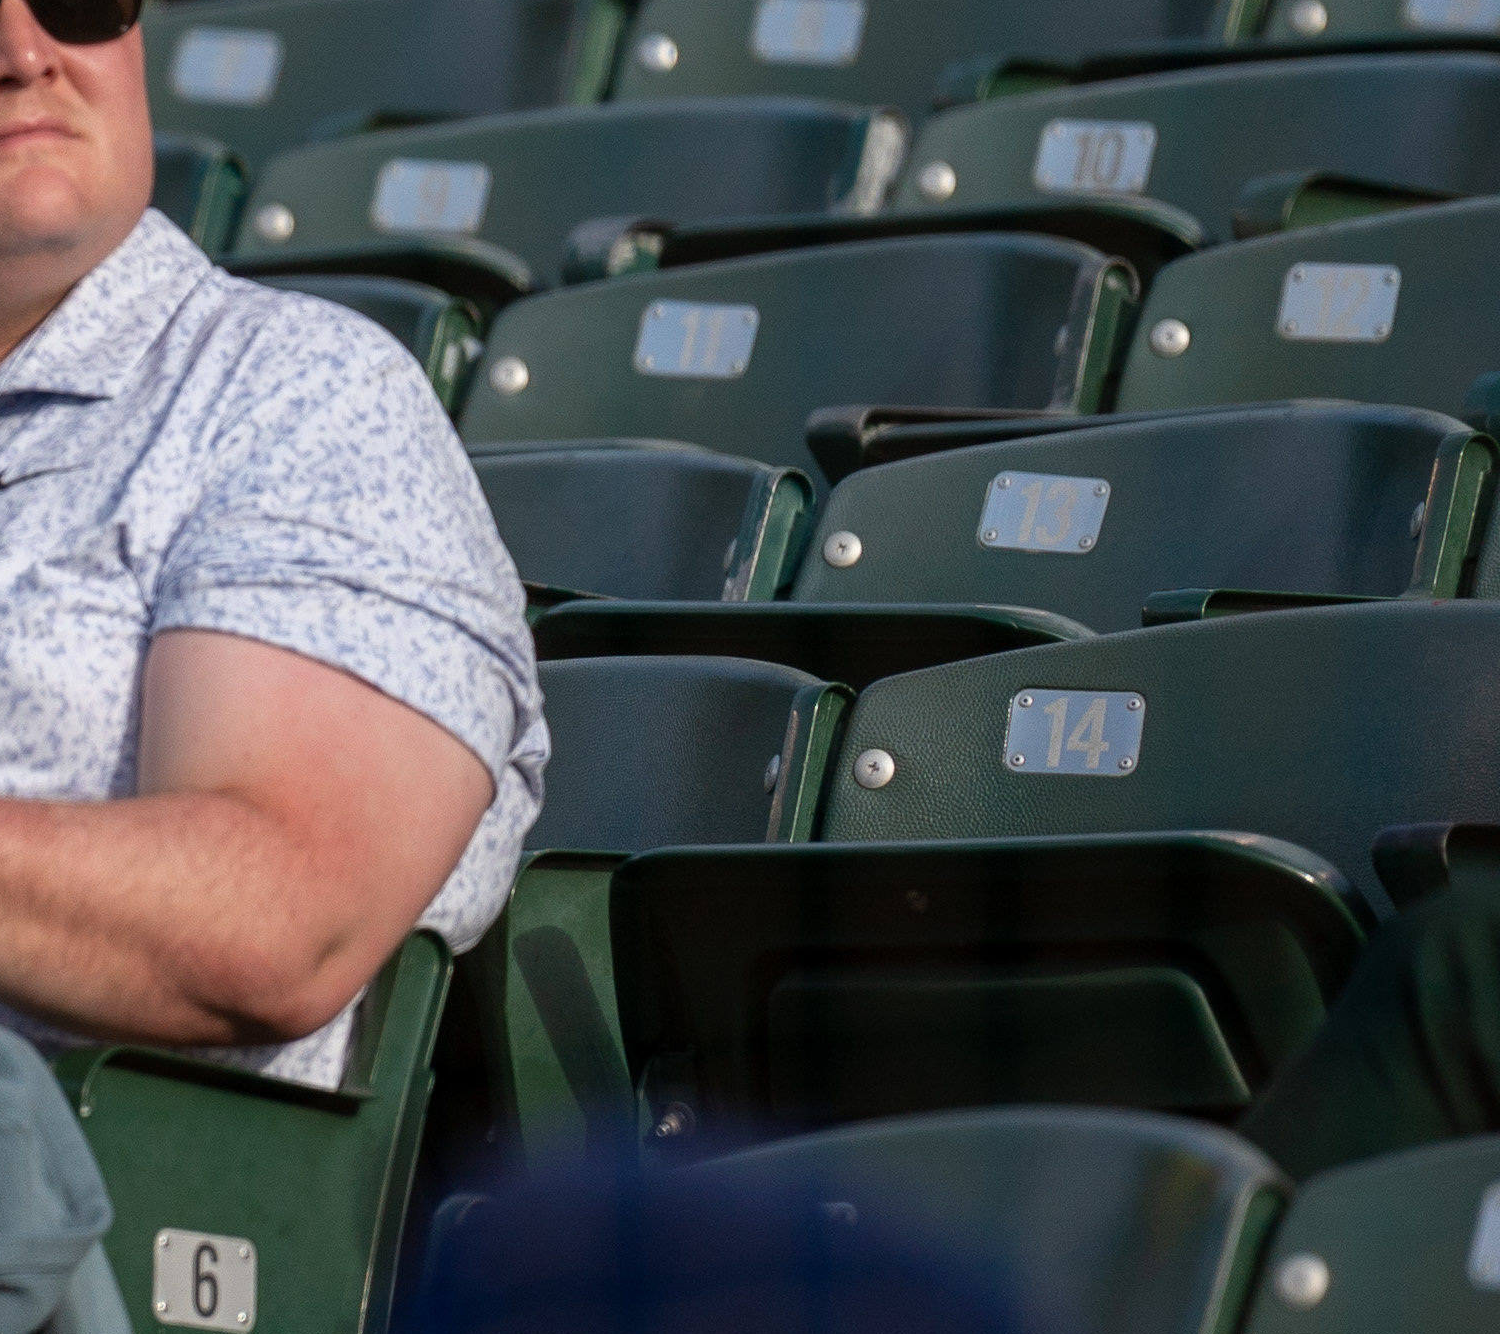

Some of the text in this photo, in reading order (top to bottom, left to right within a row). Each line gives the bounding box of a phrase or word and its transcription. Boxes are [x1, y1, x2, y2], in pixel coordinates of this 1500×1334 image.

[1071, 130, 1125, 190] 10
[1317, 271, 1375, 336] 12
[679, 310, 722, 369] 11
[1019, 479, 1079, 548] 13
[1041, 697, 1112, 769] 14
[192, 1241, 219, 1319] 6
